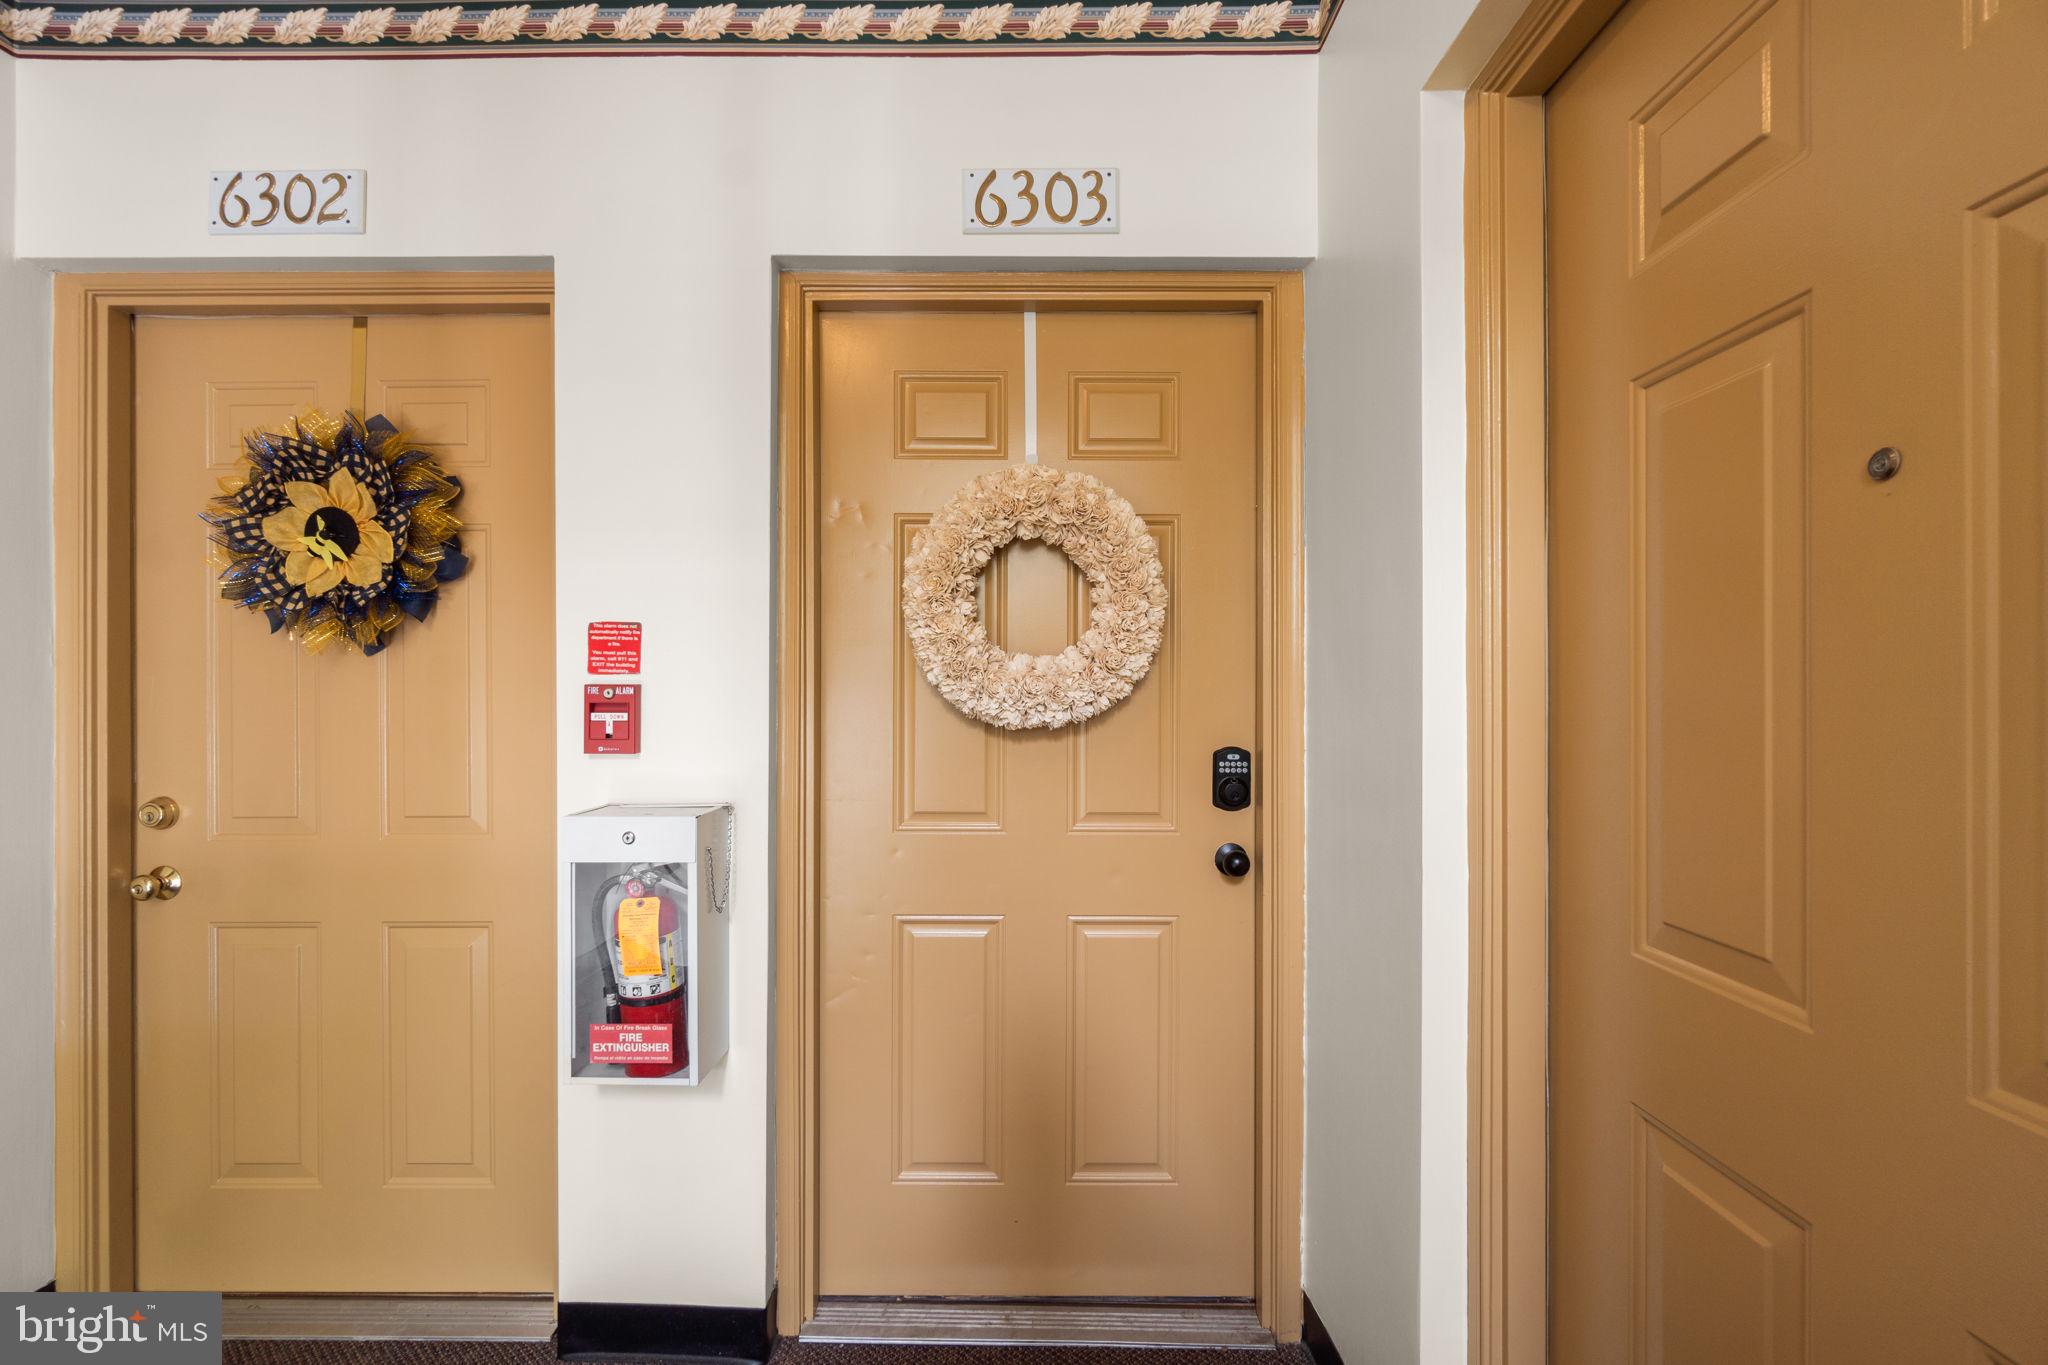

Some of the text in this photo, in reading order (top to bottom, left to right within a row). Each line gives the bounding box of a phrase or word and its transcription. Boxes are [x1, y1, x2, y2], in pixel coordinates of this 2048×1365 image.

[219, 171, 348, 228] 6302
[974, 169, 1108, 228] 6303
[587, 686, 635, 695] FIRE ALARM
[619, 1032, 643, 1042] FIRE
[592, 1042, 670, 1053] EXTINGUISHER
